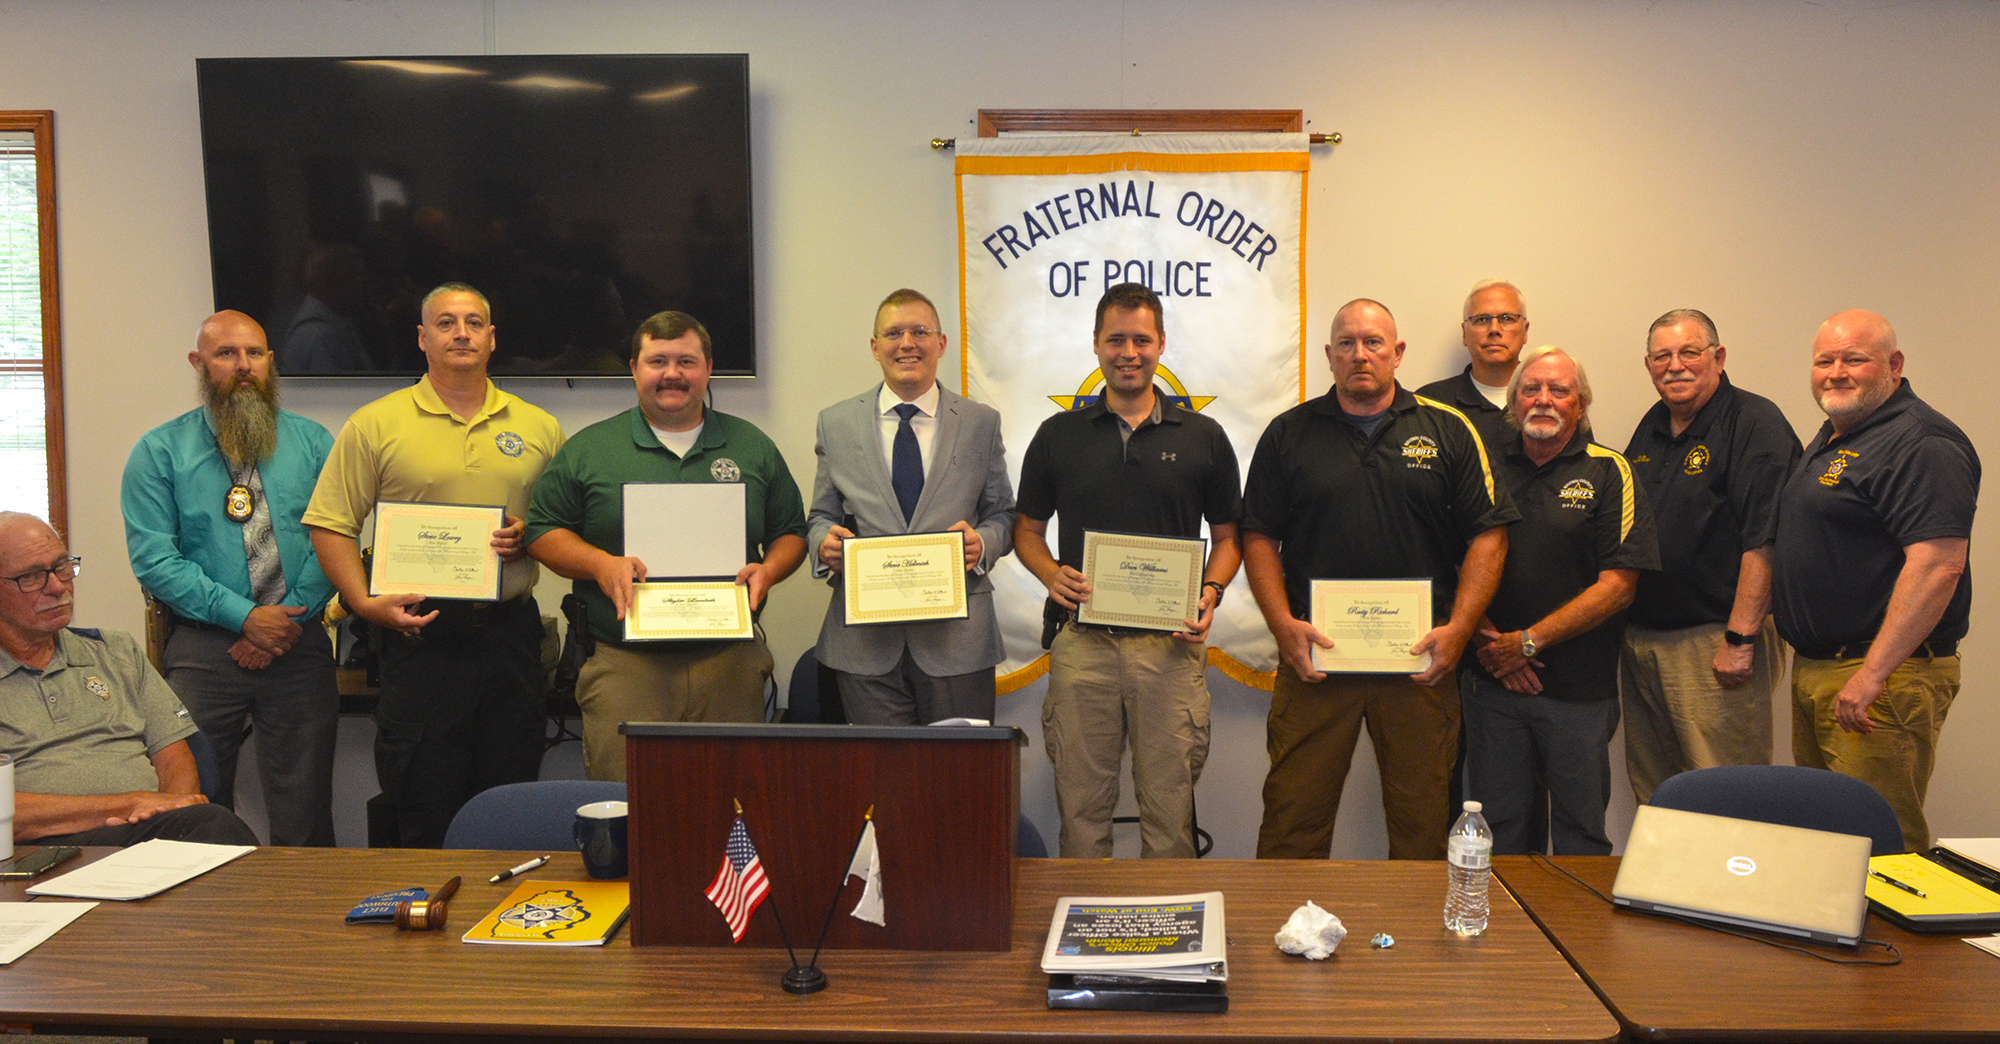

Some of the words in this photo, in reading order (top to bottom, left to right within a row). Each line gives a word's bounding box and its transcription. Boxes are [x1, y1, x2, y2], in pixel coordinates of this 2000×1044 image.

[982, 180, 1160, 270] FRATERNAL
[1177, 191, 1277, 272] ORDER
[1049, 261, 1090, 298] OF
[1104, 260, 1212, 297] POLICE
[1124, 936, 1180, 944] Memorial
